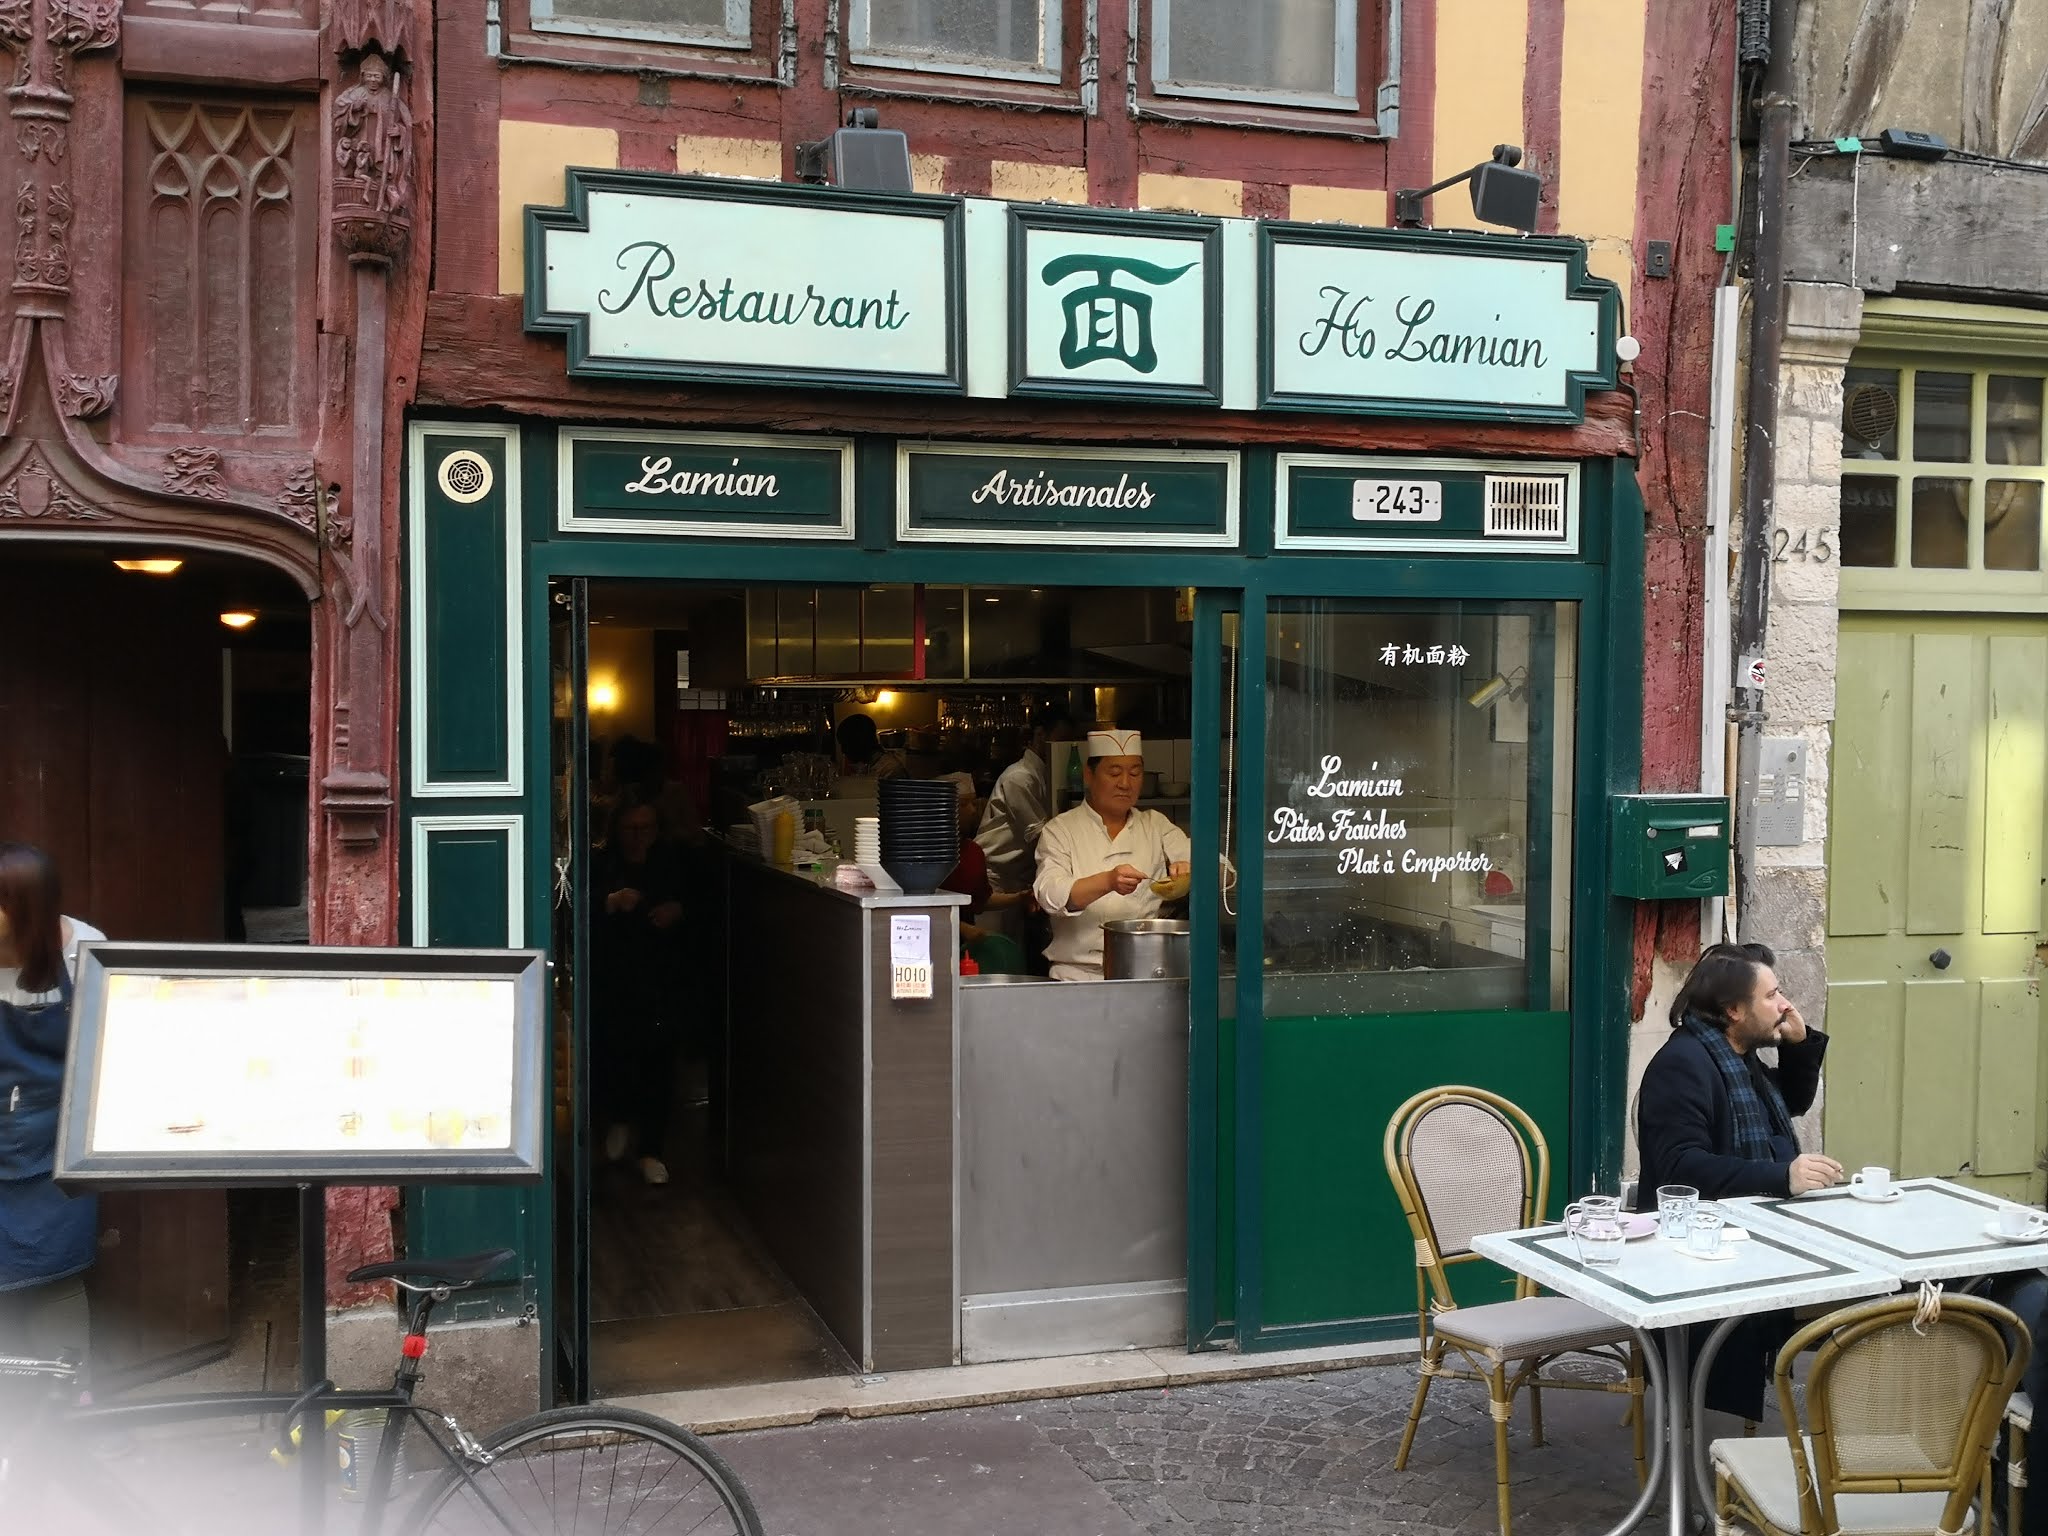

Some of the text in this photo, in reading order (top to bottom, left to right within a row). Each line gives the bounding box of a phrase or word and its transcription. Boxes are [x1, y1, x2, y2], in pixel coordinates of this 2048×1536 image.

[599, 241, 910, 330] Restaurant
[1300, 286, 1548, 369] Ho Lamian
[625, 456, 779, 497] Lamian
[972, 470, 1155, 509] Artisanales
[1771, 528, 1832, 564] 245
[1379, 643, 1470, 667] 有机面粉
[1307, 755, 1403, 798] Lamian
[1268, 807, 1406, 843] Pâtes Fraîches
[1338, 847, 1493, 883] Plat à Emporter
